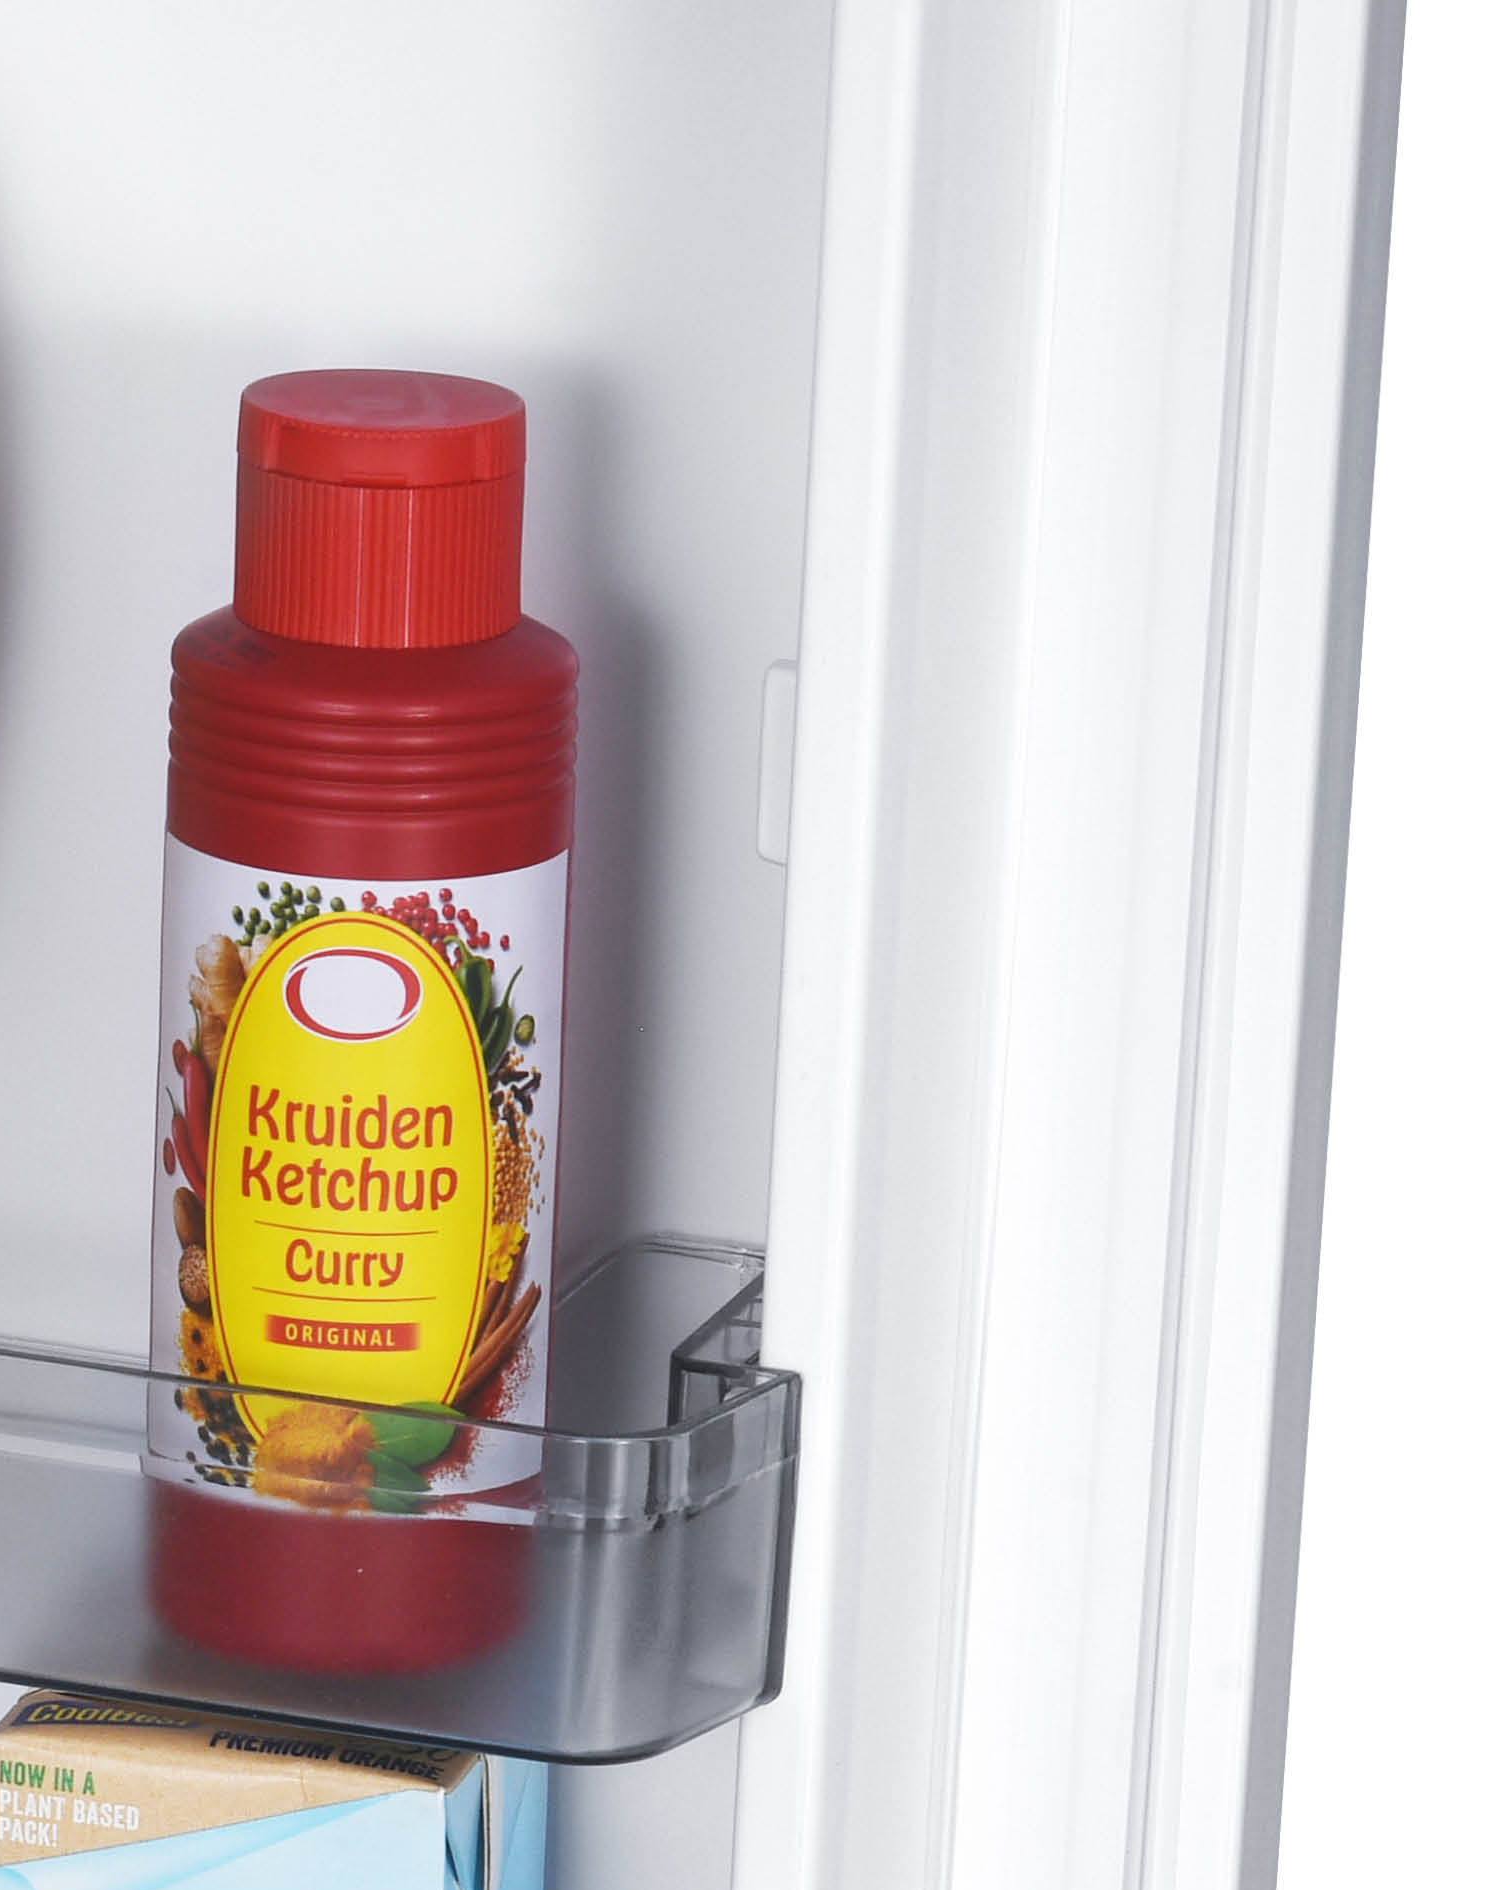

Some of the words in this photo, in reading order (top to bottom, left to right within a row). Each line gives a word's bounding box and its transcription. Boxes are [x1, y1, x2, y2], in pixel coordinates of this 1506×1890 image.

[247, 1083, 454, 1151] Kruiden
[241, 1145, 459, 1213] Ketchup
[285, 1238, 405, 1288] Curry
[285, 1322, 397, 1347] ORIGINAL
[209, 1729, 336, 1761] PREMIUM
[338, 1750, 445, 1780] ORANGE
[54, 1766, 76, 1794] IN
[82, 1770, 97, 1796] A
[72, 1799, 141, 1832] BASED
